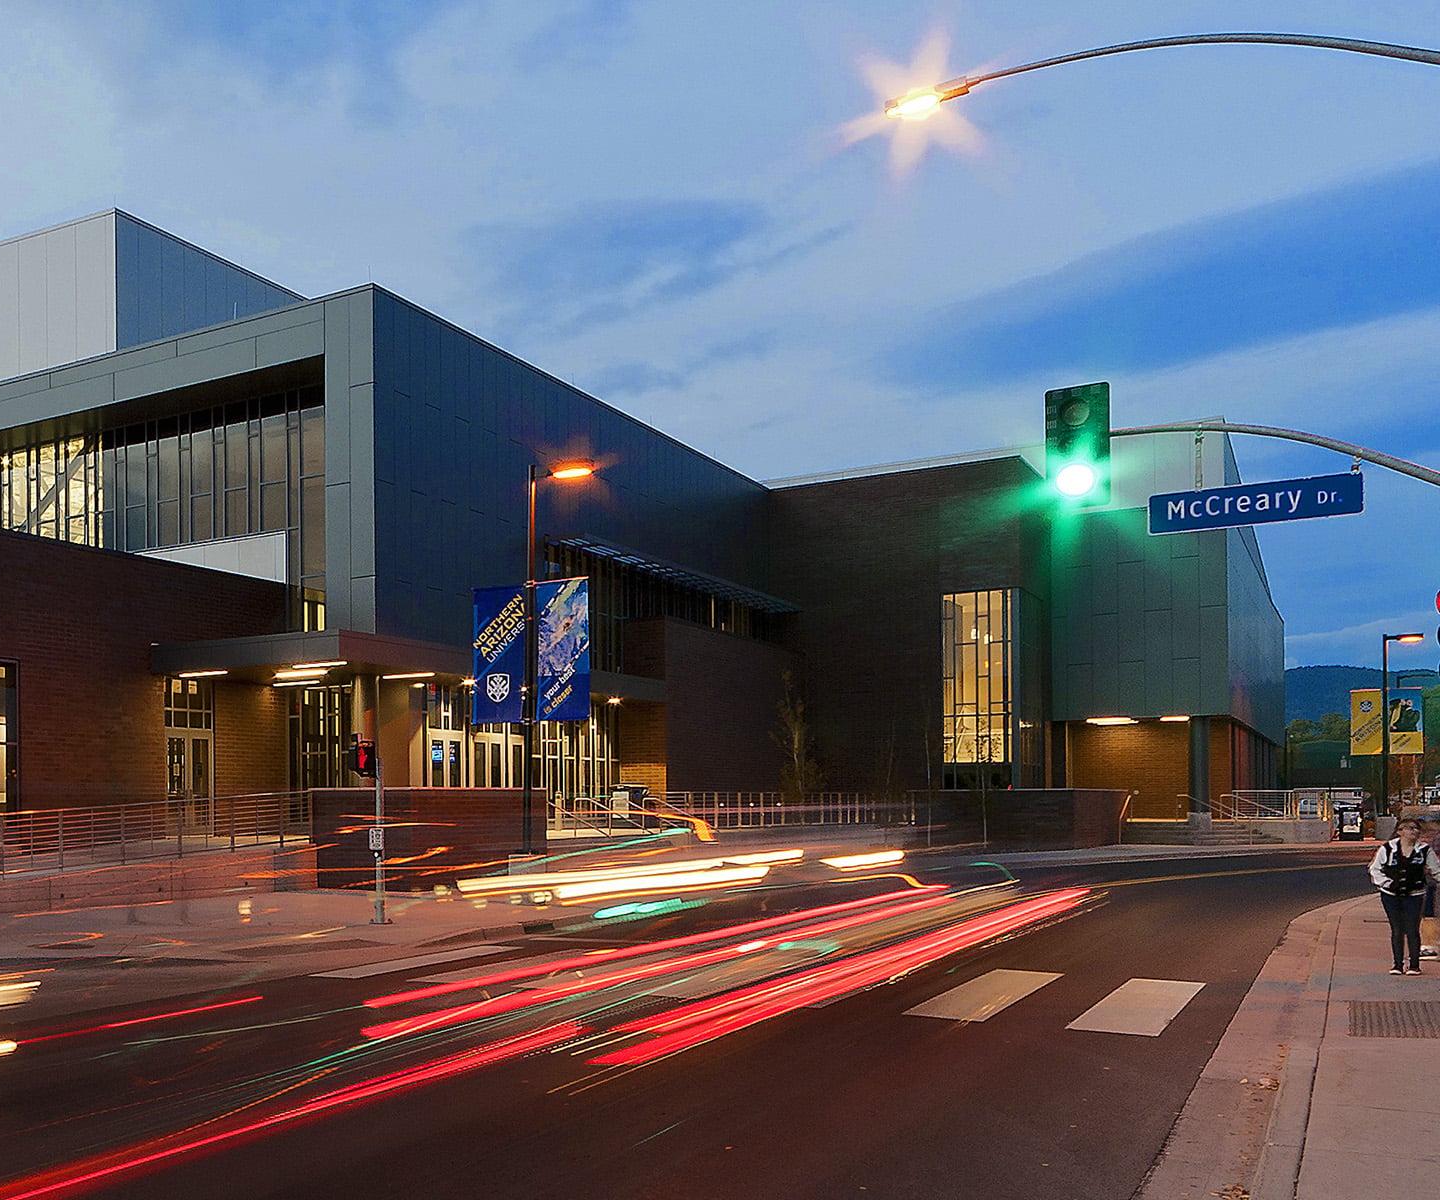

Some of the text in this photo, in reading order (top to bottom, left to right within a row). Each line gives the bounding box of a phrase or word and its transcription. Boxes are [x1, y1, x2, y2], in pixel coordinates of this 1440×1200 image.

[1167, 489, 1343, 521] McCreary Dr.
[473, 593, 523, 649] NORTHERN
[543, 666, 576, 701] your best
[543, 684, 573, 714] is closer
